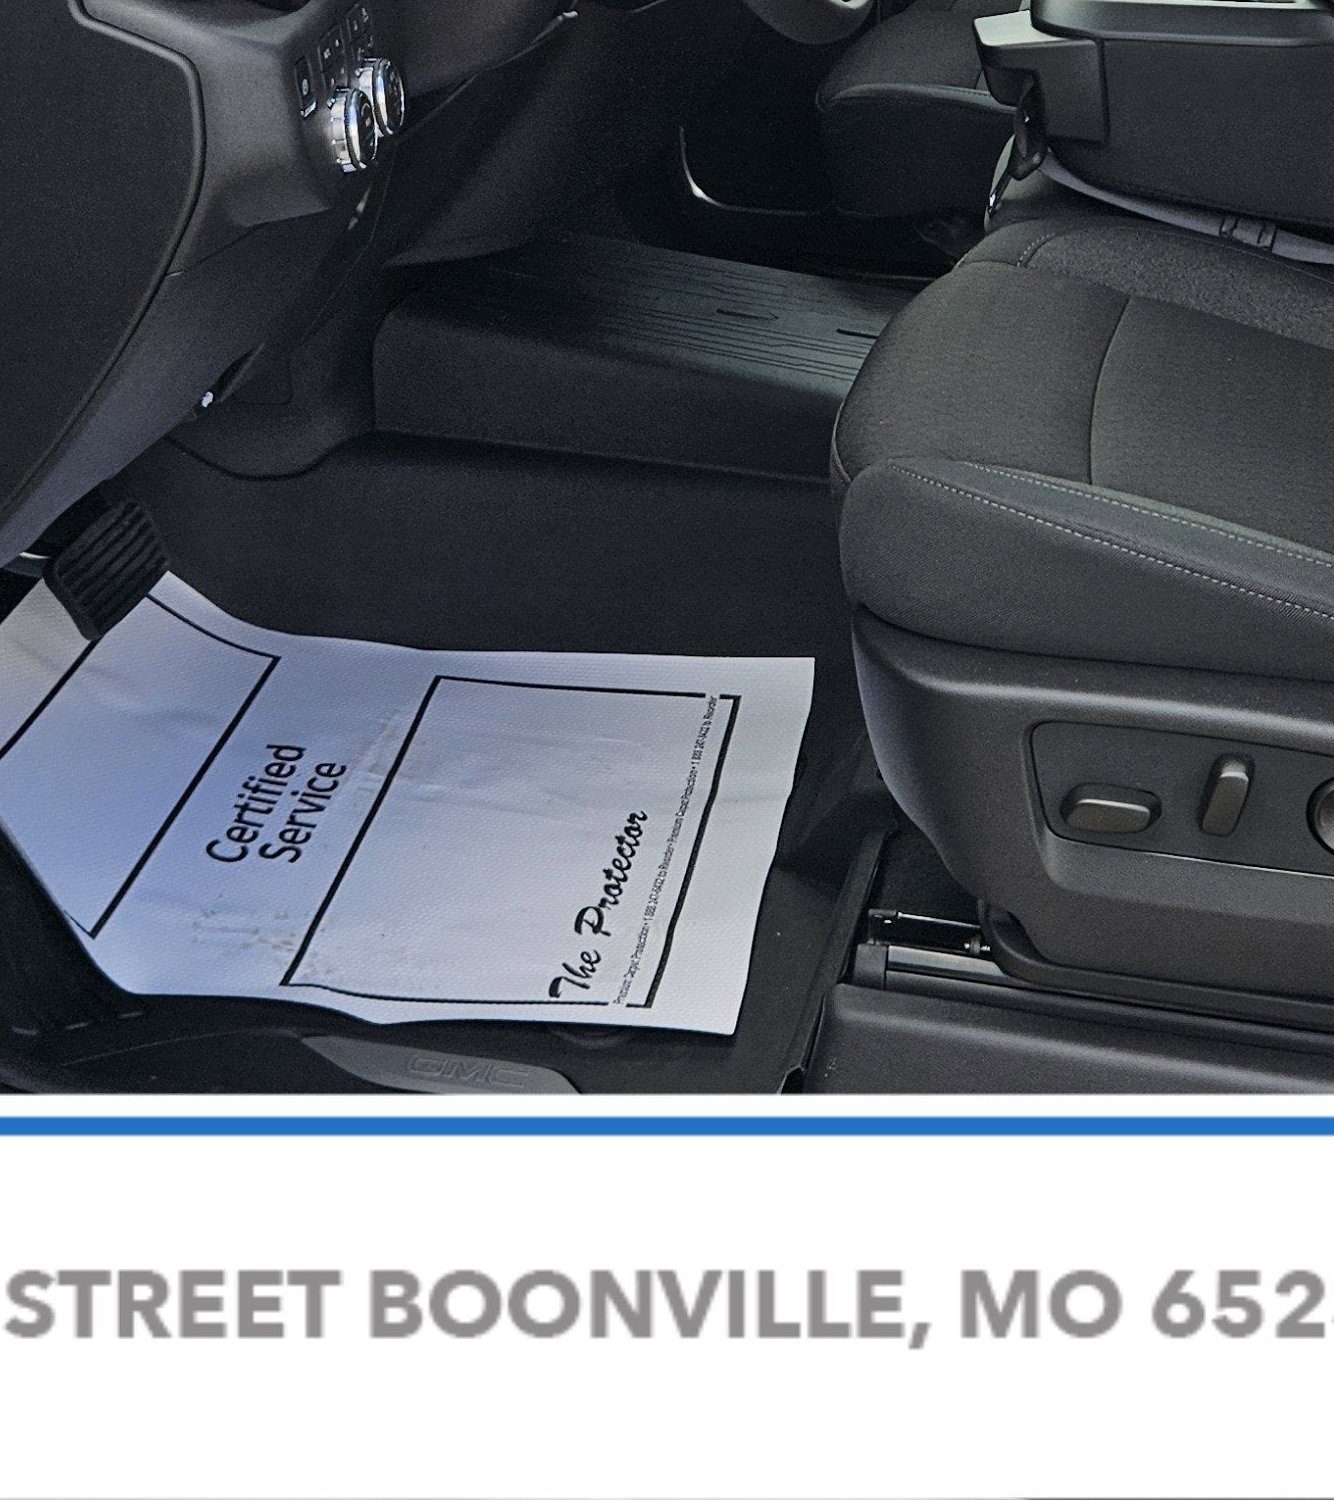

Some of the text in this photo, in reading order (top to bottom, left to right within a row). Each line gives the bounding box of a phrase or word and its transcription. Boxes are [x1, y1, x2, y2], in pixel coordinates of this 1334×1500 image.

[205, 744, 307, 863] Certified
[258, 762, 347, 864] Service
[548, 810, 648, 999] The Protector
[408, 1056, 530, 1088] GMC
